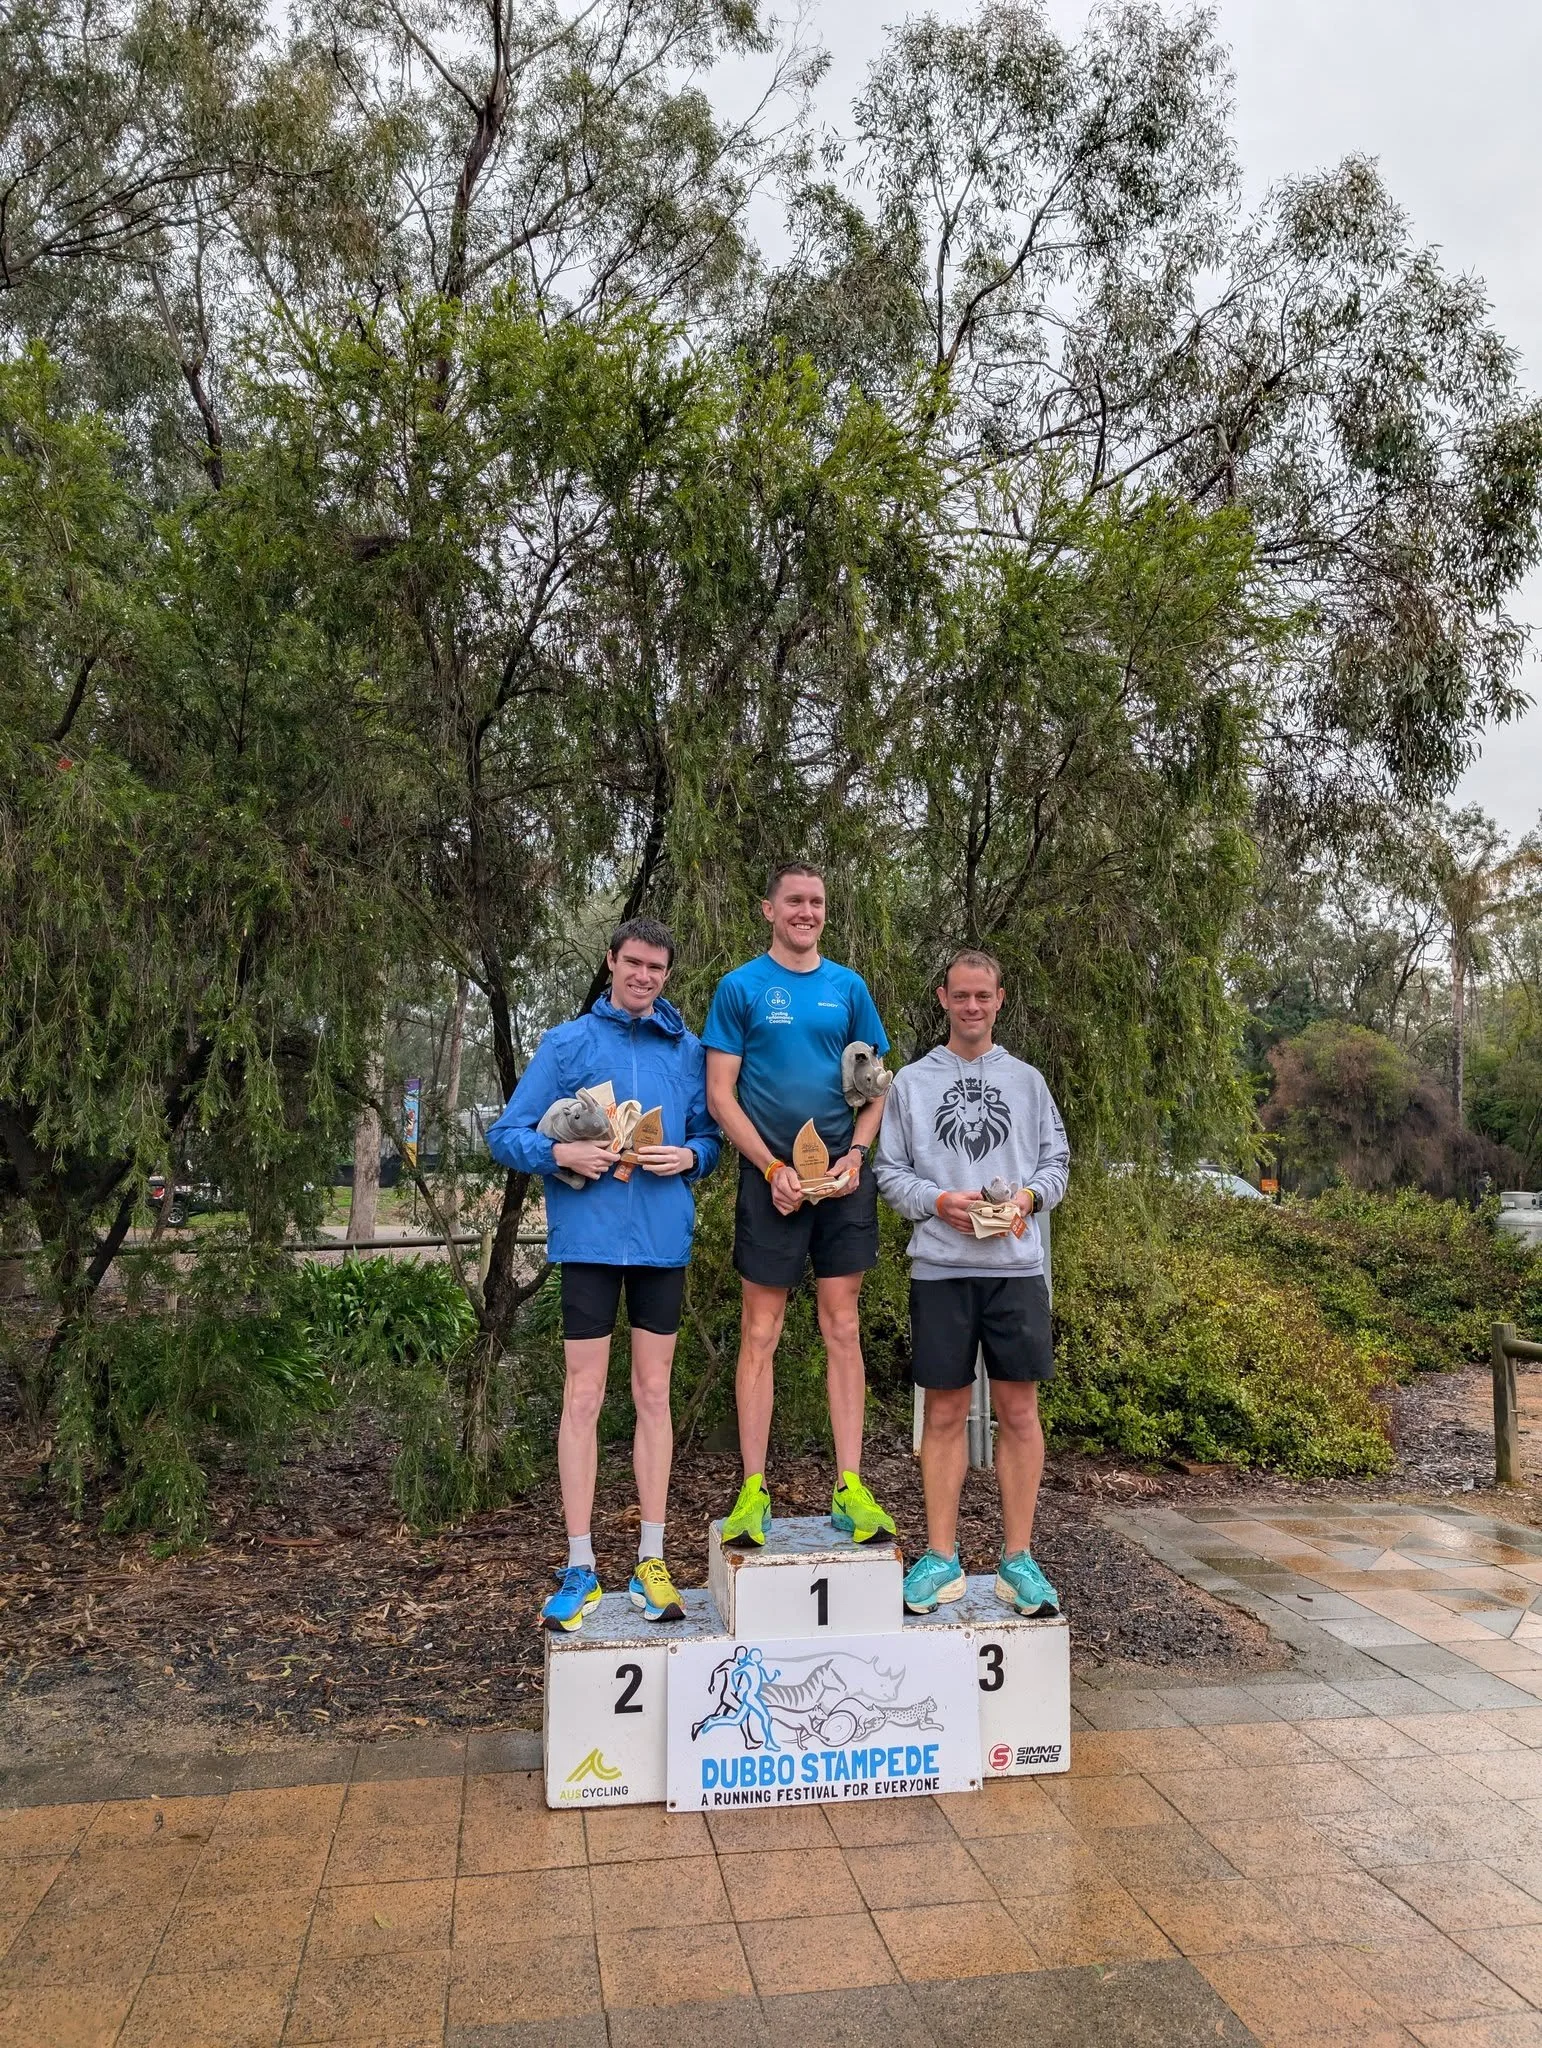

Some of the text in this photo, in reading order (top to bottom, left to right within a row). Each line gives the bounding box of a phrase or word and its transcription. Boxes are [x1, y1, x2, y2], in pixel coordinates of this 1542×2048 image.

[809, 1578, 829, 1626] 1
[978, 1643, 1005, 1692] 3
[614, 1663, 643, 1714] 2
[702, 1743, 940, 1789] DUBBO STAMPEDE
[1015, 1753, 1060, 1765] SIGNS
[1016, 1744, 1062, 1756] SIMMO
[559, 1785, 629, 1800] AUSCYCLING
[701, 1777, 940, 1806] A RUNNING FESTIVAL FOR EVERYONE
